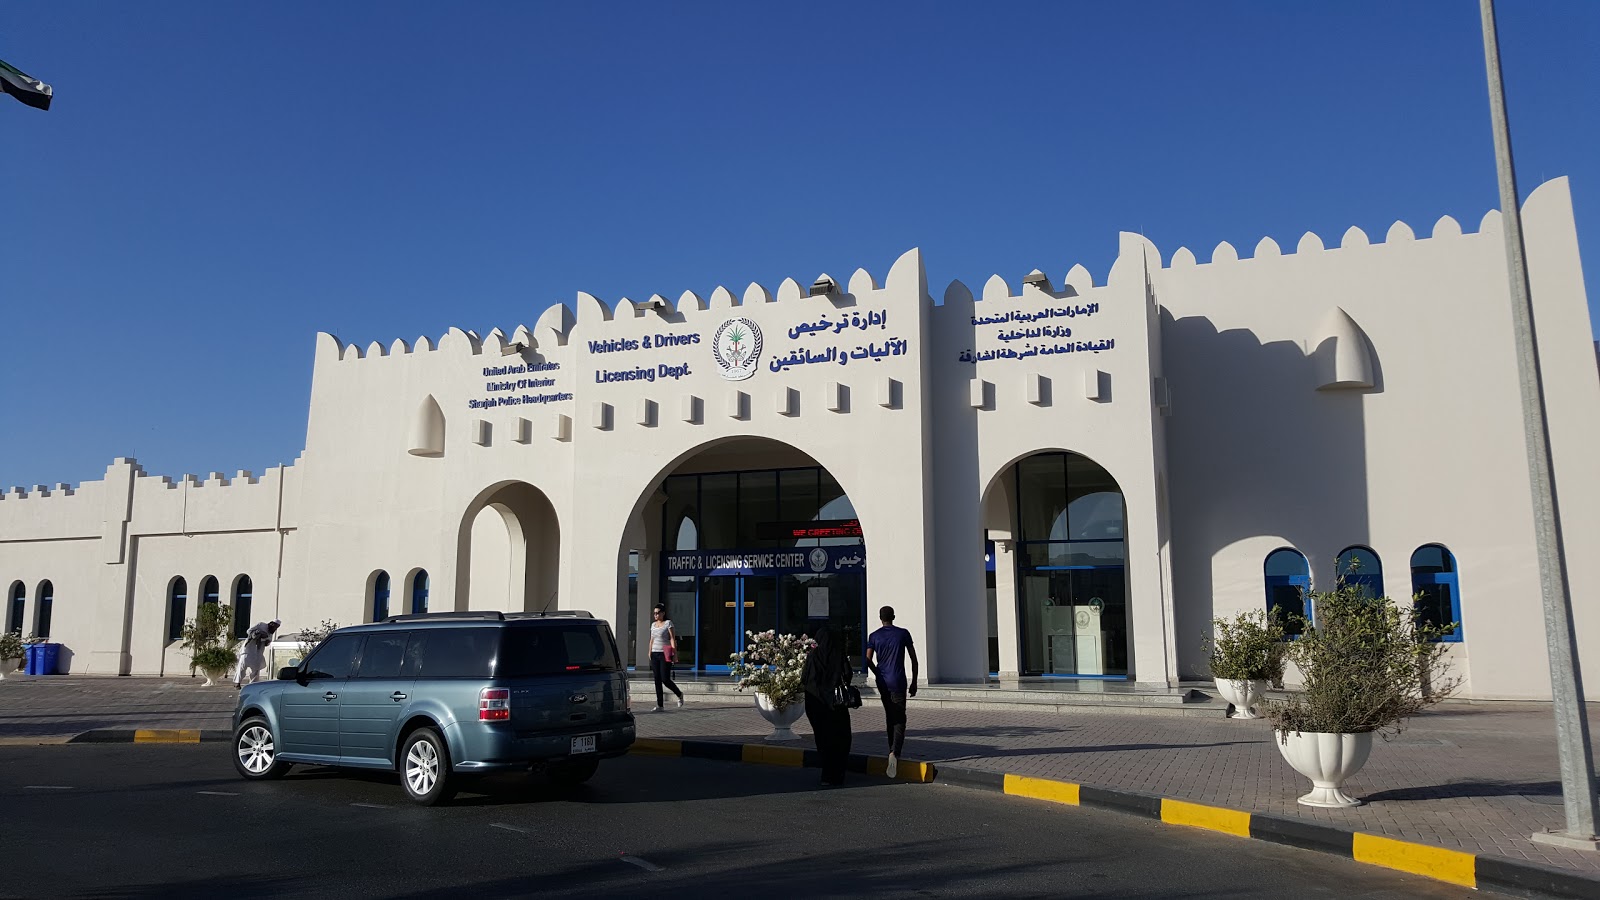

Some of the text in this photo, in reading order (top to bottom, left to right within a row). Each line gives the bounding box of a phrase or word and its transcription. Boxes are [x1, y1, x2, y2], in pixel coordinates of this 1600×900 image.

[788, 309, 886, 339] إدارة ترخيص
[971, 303, 1098, 326] الإمارات العربية المتحدة
[588, 332, 700, 354] Vehicles & Drivers
[998, 326, 1072, 342] وزارة الداخلية
[850, 337, 906, 362] الآليات
[958, 338, 1115, 364] القيادة العامة لشرطة الشارقة
[483, 362, 560, 376] United Arab Emirates
[595, 362, 692, 383] Licensing Dept.
[486, 377, 556, 392] Ministry Of Interior
[468, 392, 573, 409] Sharjah Police Headquarters
[668, 554, 804, 569] TRAFFIC & LICENSING SERVICE CENTER
